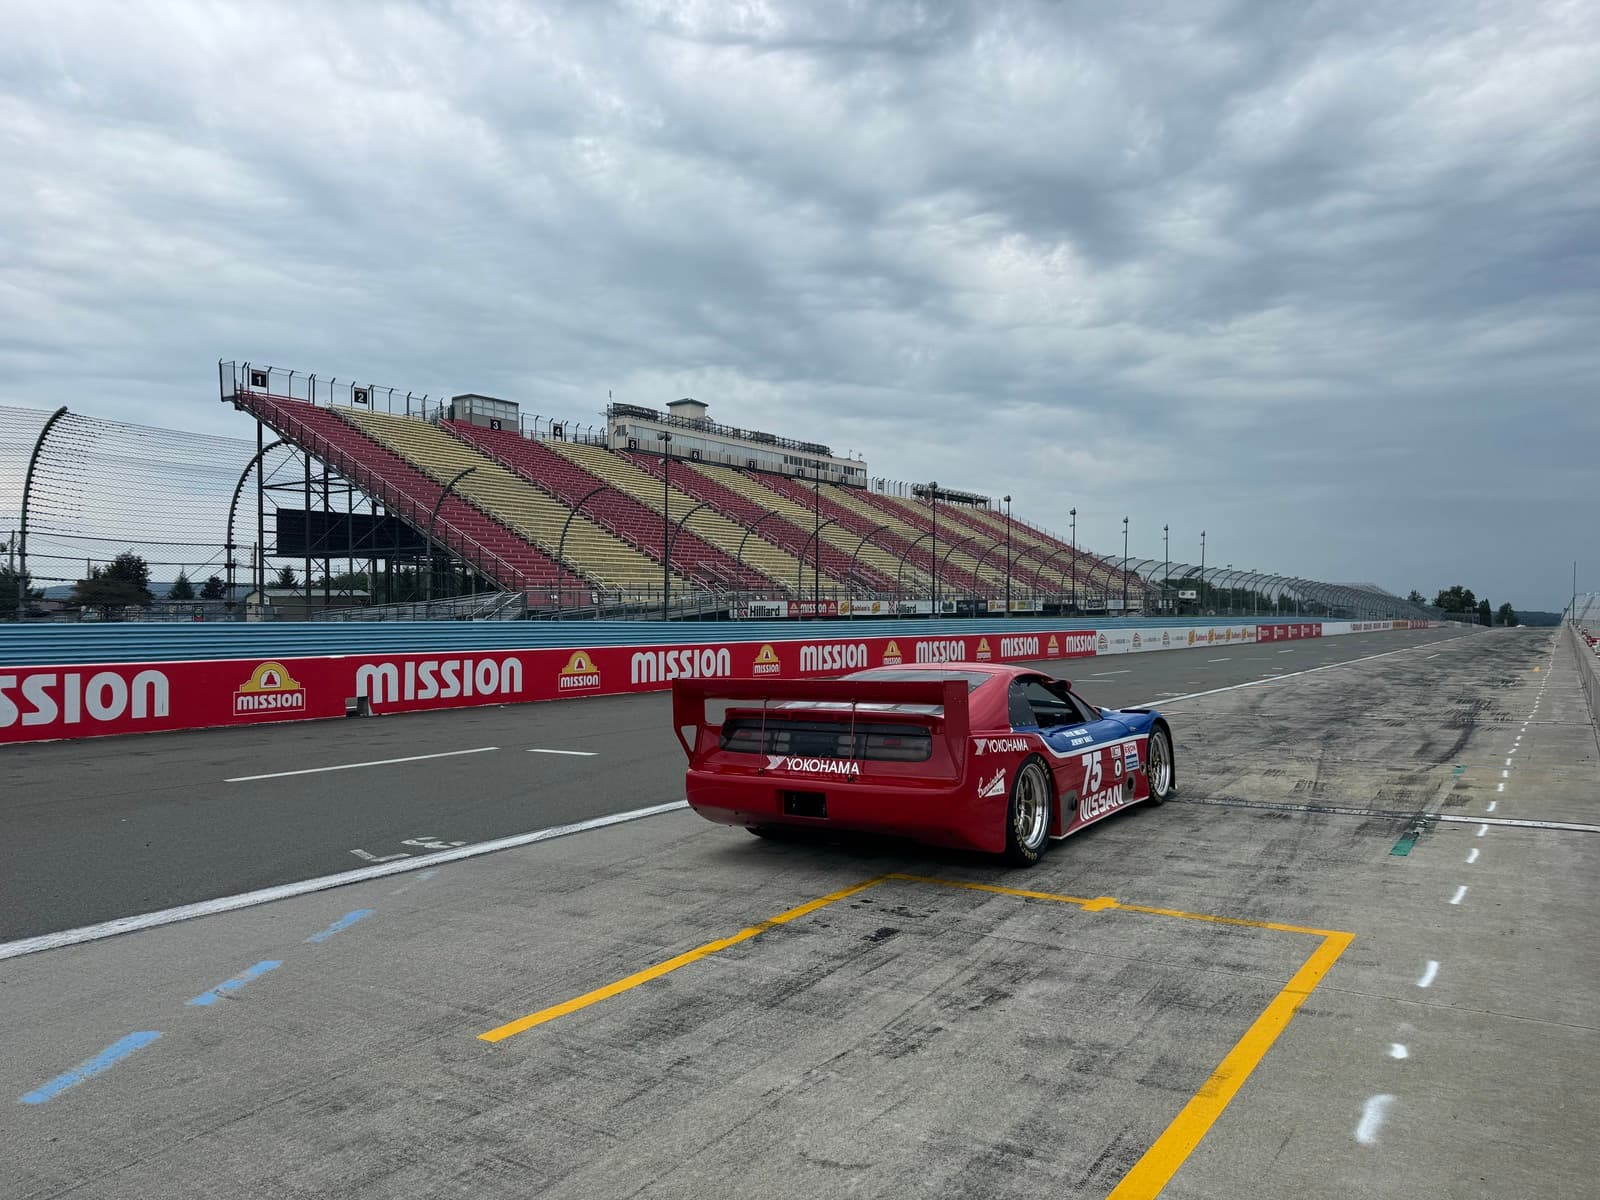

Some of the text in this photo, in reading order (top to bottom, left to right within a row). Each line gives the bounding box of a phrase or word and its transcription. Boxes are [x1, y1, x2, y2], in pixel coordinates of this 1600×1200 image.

[357, 392, 364, 402] 2
[493, 421, 499, 430] 3
[750, 604, 780, 617] Hilliard
[800, 602, 827, 613] MISSON
[916, 640, 965, 664] MISSION
[1000, 636, 1039, 657] MISSION
[1066, 634, 1097, 653] MISSION
[631, 648, 731, 684] MISSION
[800, 643, 868, 672] MISSION
[754, 663, 779, 673] MISSION
[356, 657, 523, 704] MISSION
[560, 675, 599, 688] MISSION
[237, 692, 302, 711] MISSION
[987, 738, 1029, 753] YOKOHAMA
[785, 758, 860, 775] YOKOHAMA
[1081, 751, 1103, 796] 75
[1080, 783, 1124, 822] NISSAN
